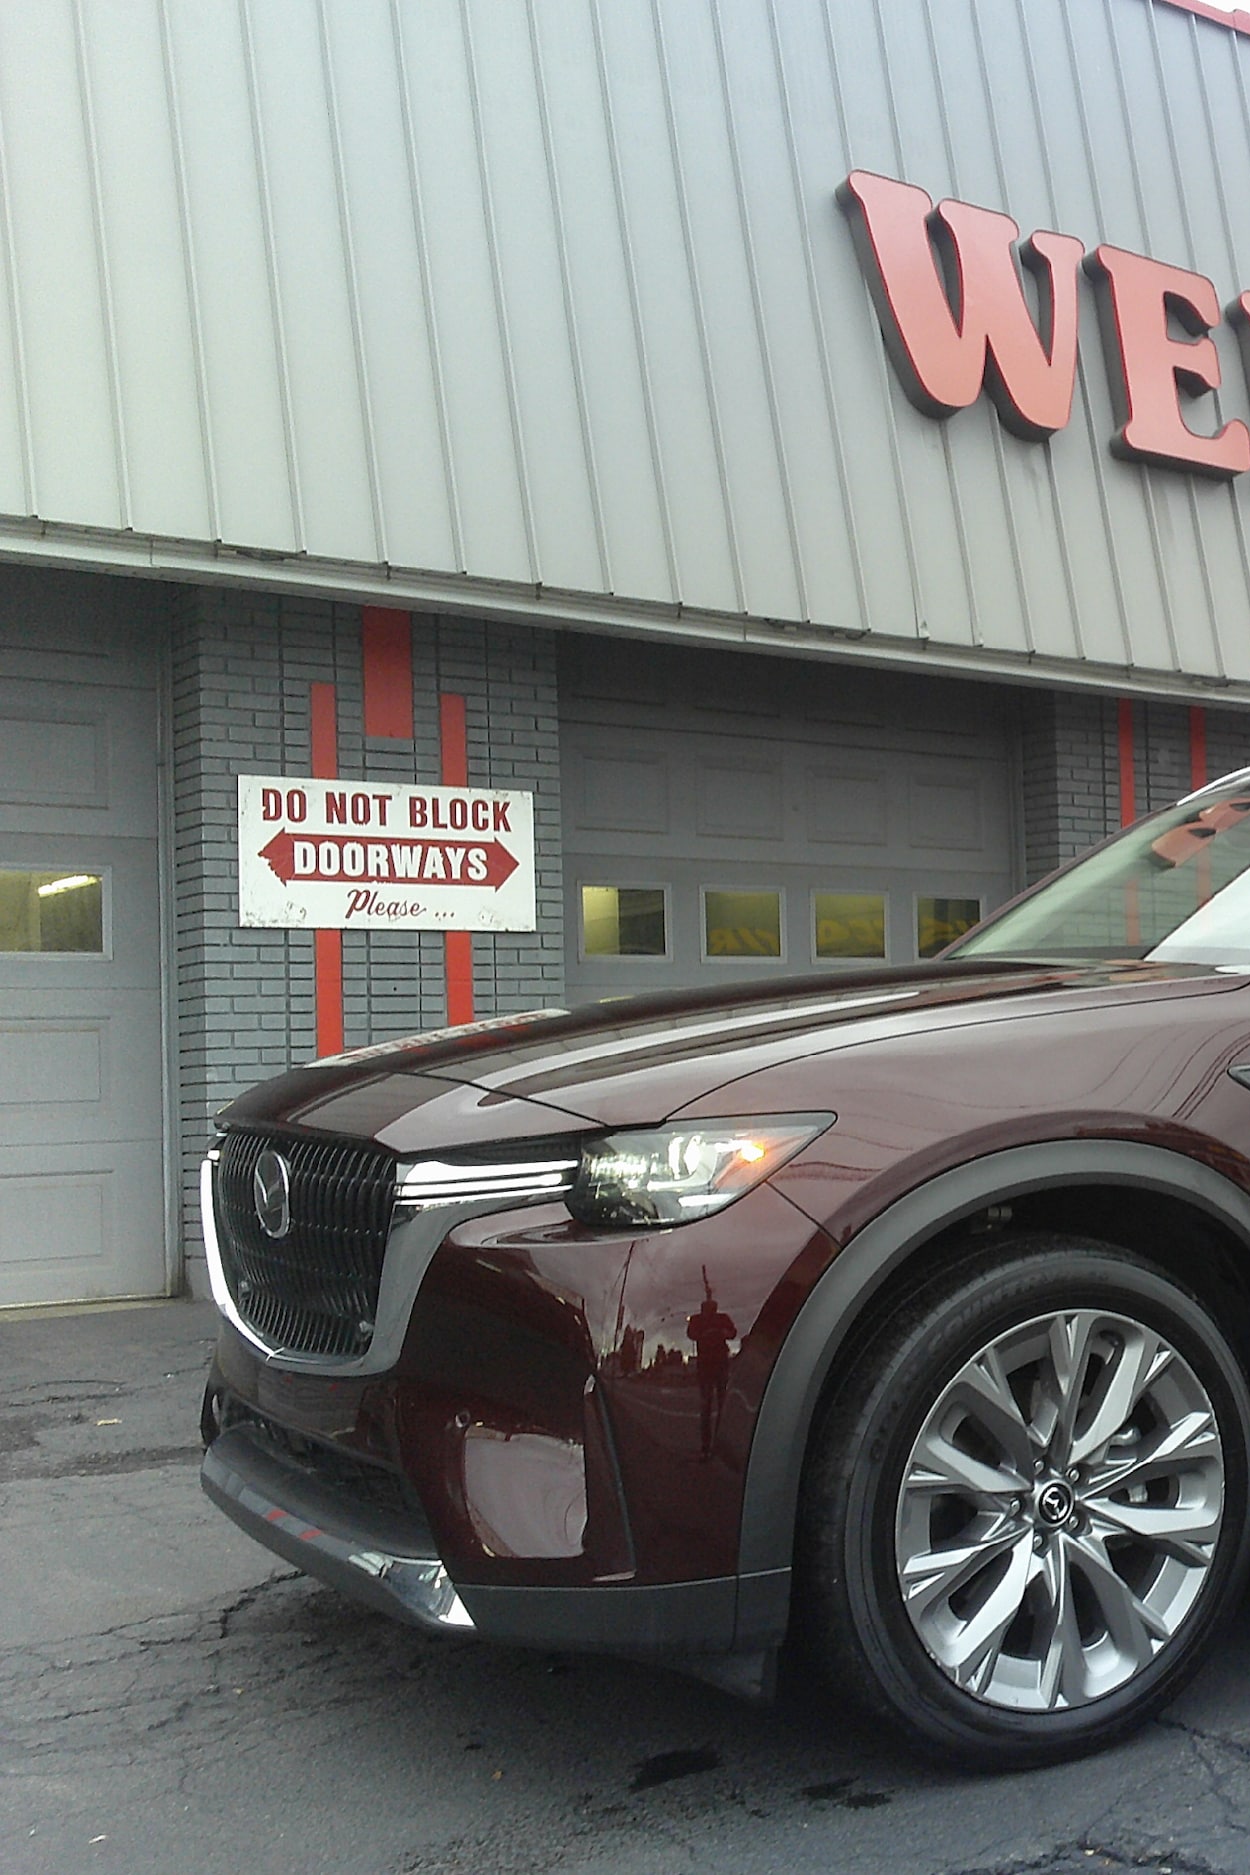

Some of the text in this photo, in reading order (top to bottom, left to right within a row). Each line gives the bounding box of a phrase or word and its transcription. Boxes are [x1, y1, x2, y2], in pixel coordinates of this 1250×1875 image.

[261, 787, 512, 832] DO NOT BLOCK
[293, 840, 487, 881] DOORWAYS
